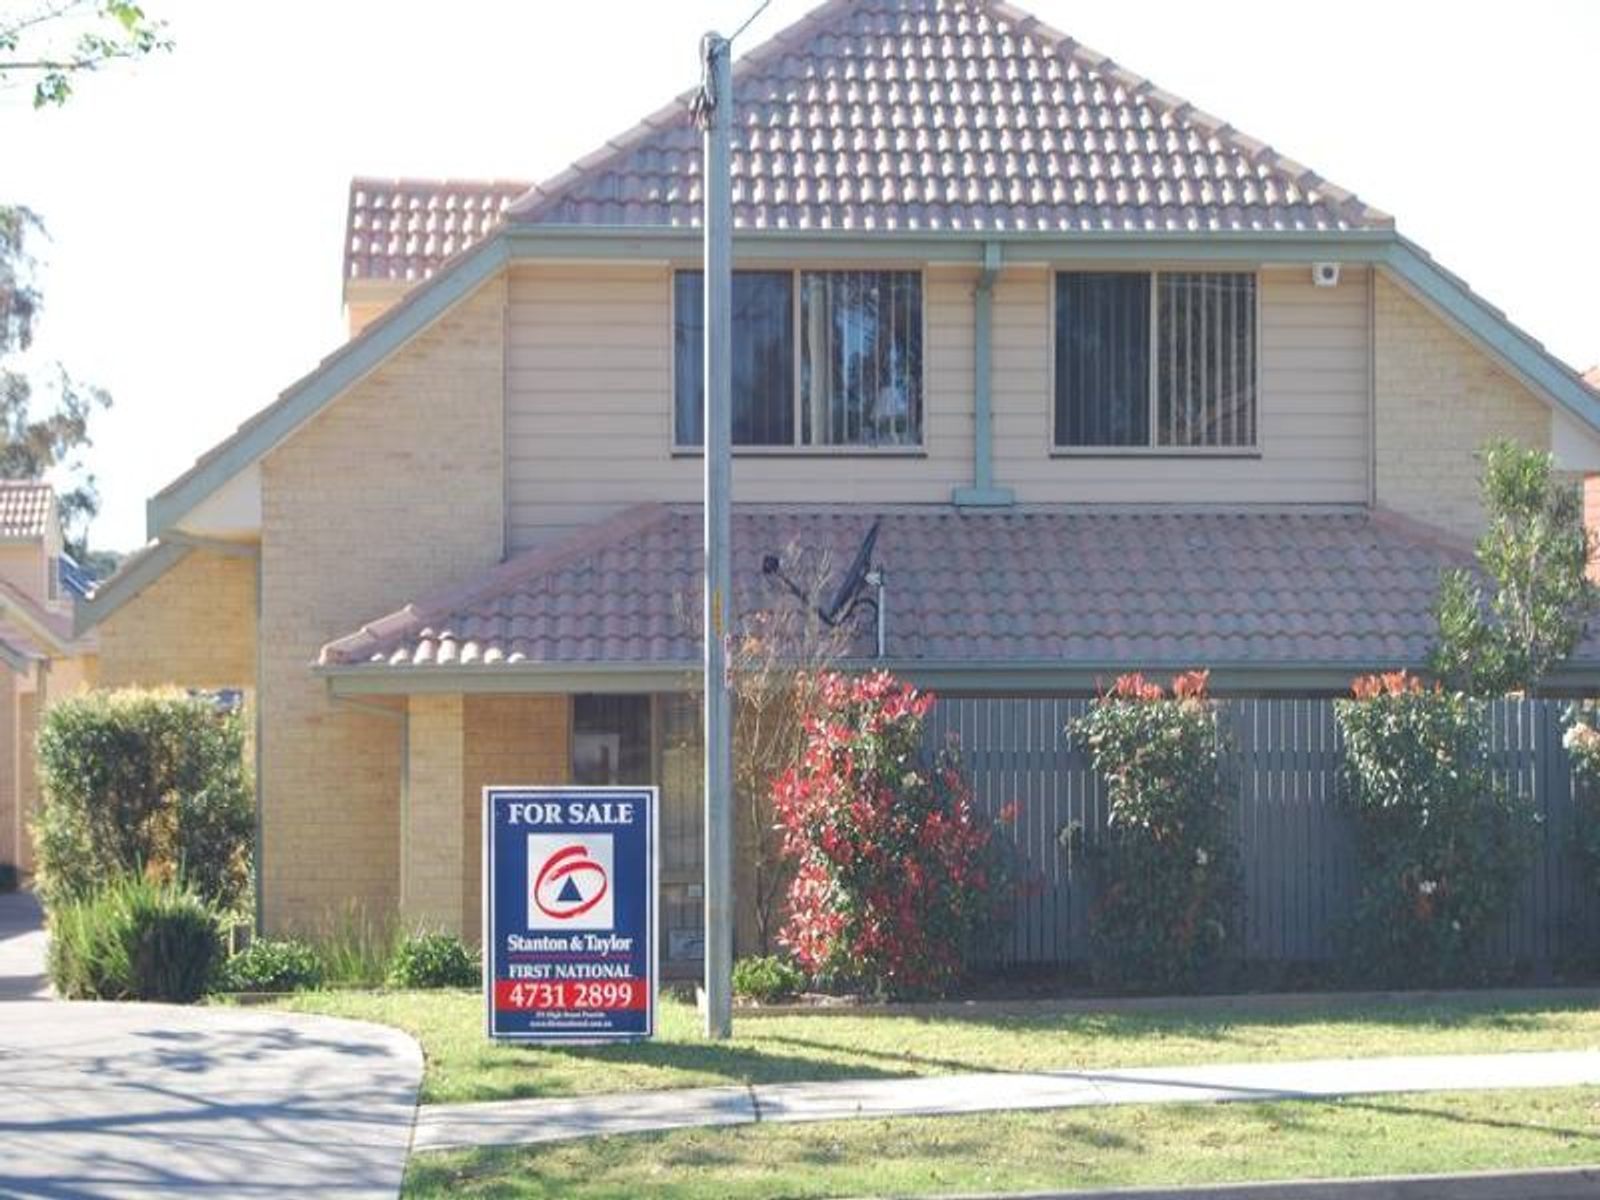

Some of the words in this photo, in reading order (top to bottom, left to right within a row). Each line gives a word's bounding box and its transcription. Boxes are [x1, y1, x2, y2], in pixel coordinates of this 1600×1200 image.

[508, 803, 563, 824] FOR
[568, 803, 633, 824] SALE
[507, 934, 567, 951] Stanton
[570, 935, 583, 951] &
[584, 934, 633, 957] Taylor
[509, 963, 550, 978] FIRST
[555, 963, 633, 978] NATIONAL
[509, 983, 565, 1008] 4731
[574, 983, 632, 1008] 2899
